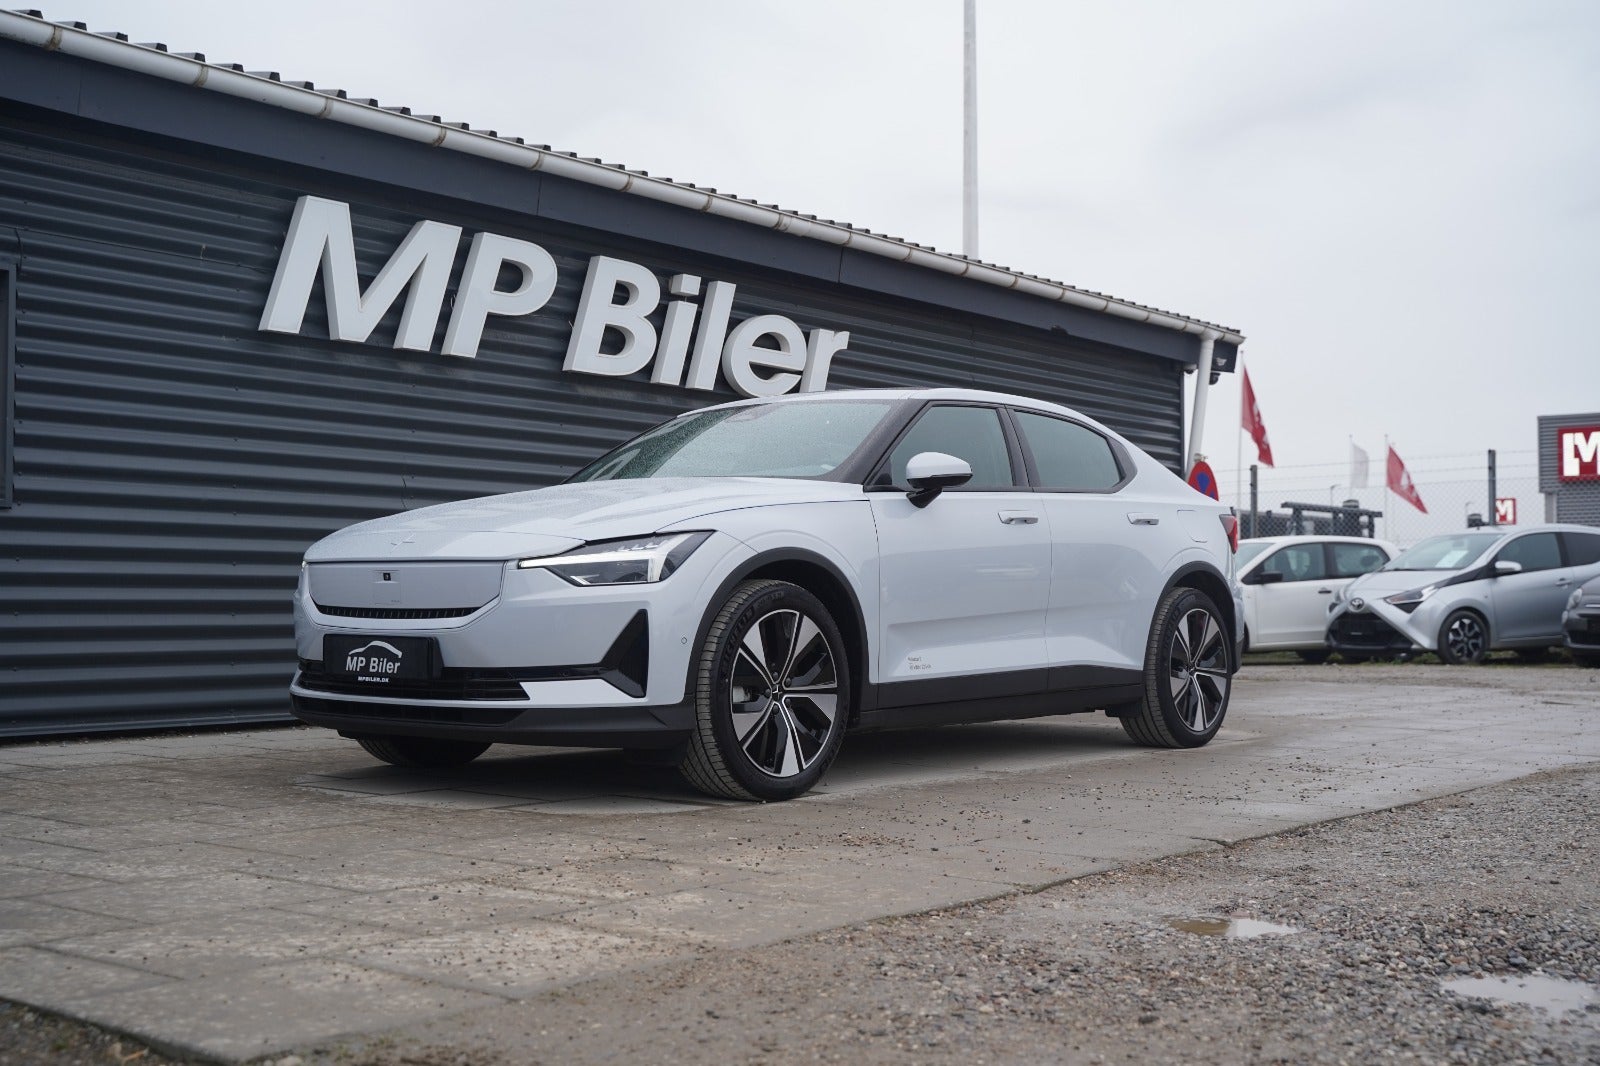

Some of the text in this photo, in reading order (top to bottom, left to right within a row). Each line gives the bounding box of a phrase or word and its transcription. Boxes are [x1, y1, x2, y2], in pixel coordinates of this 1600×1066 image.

[258, 195, 849, 398] MP Biler
[345, 656, 401, 674] MP Biler
[357, 675, 389, 683] MPBILER.DK
